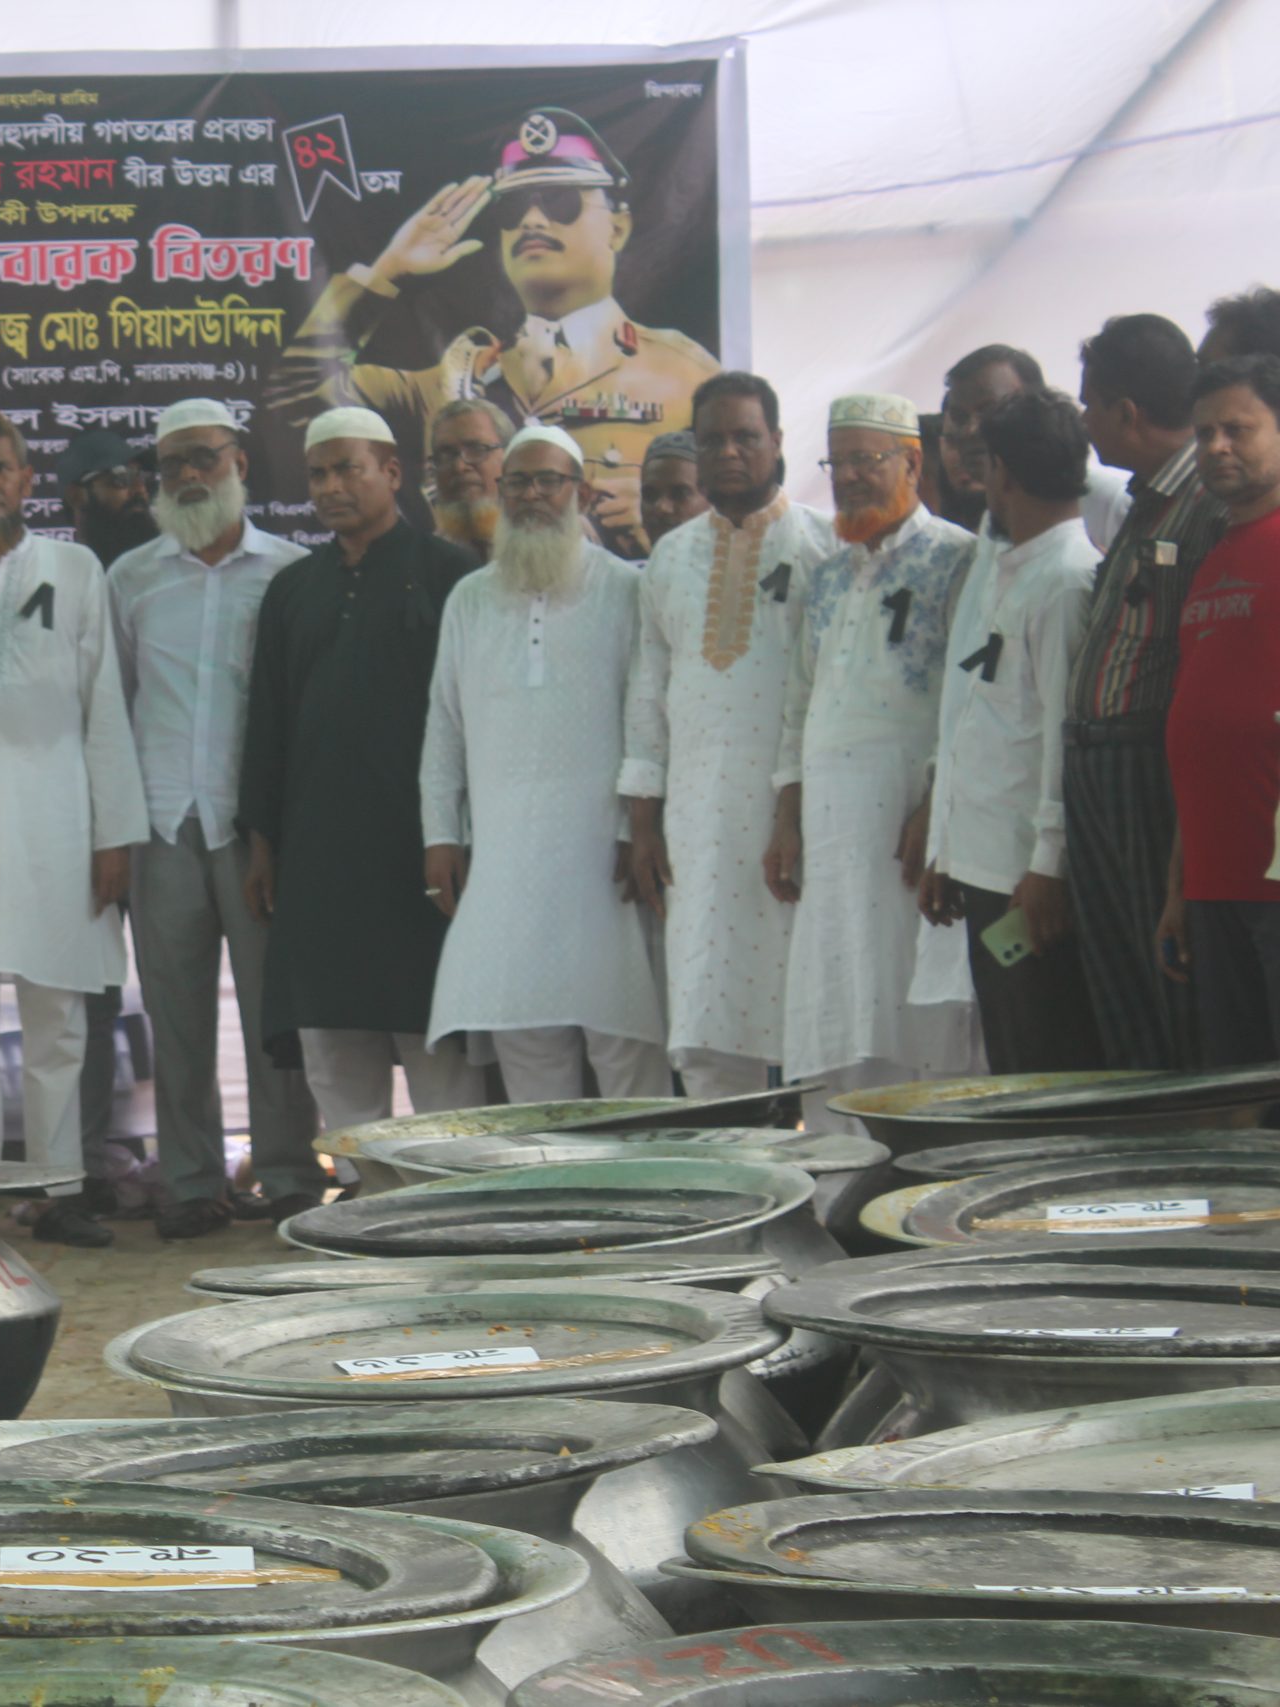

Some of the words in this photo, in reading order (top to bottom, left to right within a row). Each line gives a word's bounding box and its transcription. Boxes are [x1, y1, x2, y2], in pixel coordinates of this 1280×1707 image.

[93, 118, 196, 143] গণতন্ত্রের
[202, 117, 276, 142] প্রবক্তা
[14, 157, 118, 190] রহমান
[122, 156, 166, 188] বীর
[172, 157, 232, 187] উত্তম
[238, 163, 277, 186] এর
[293, 133, 345, 169] ৪২
[359, 170, 402, 193] তম
[35, 200, 138, 224] উপলক্ষে
[149, 223, 314, 287] বিতরণ
[39, 310, 100, 351] মোঃ
[109, 293, 285, 350] গিয়াসউদ্দিন
[26, 1546, 222, 1563] নং-২০
